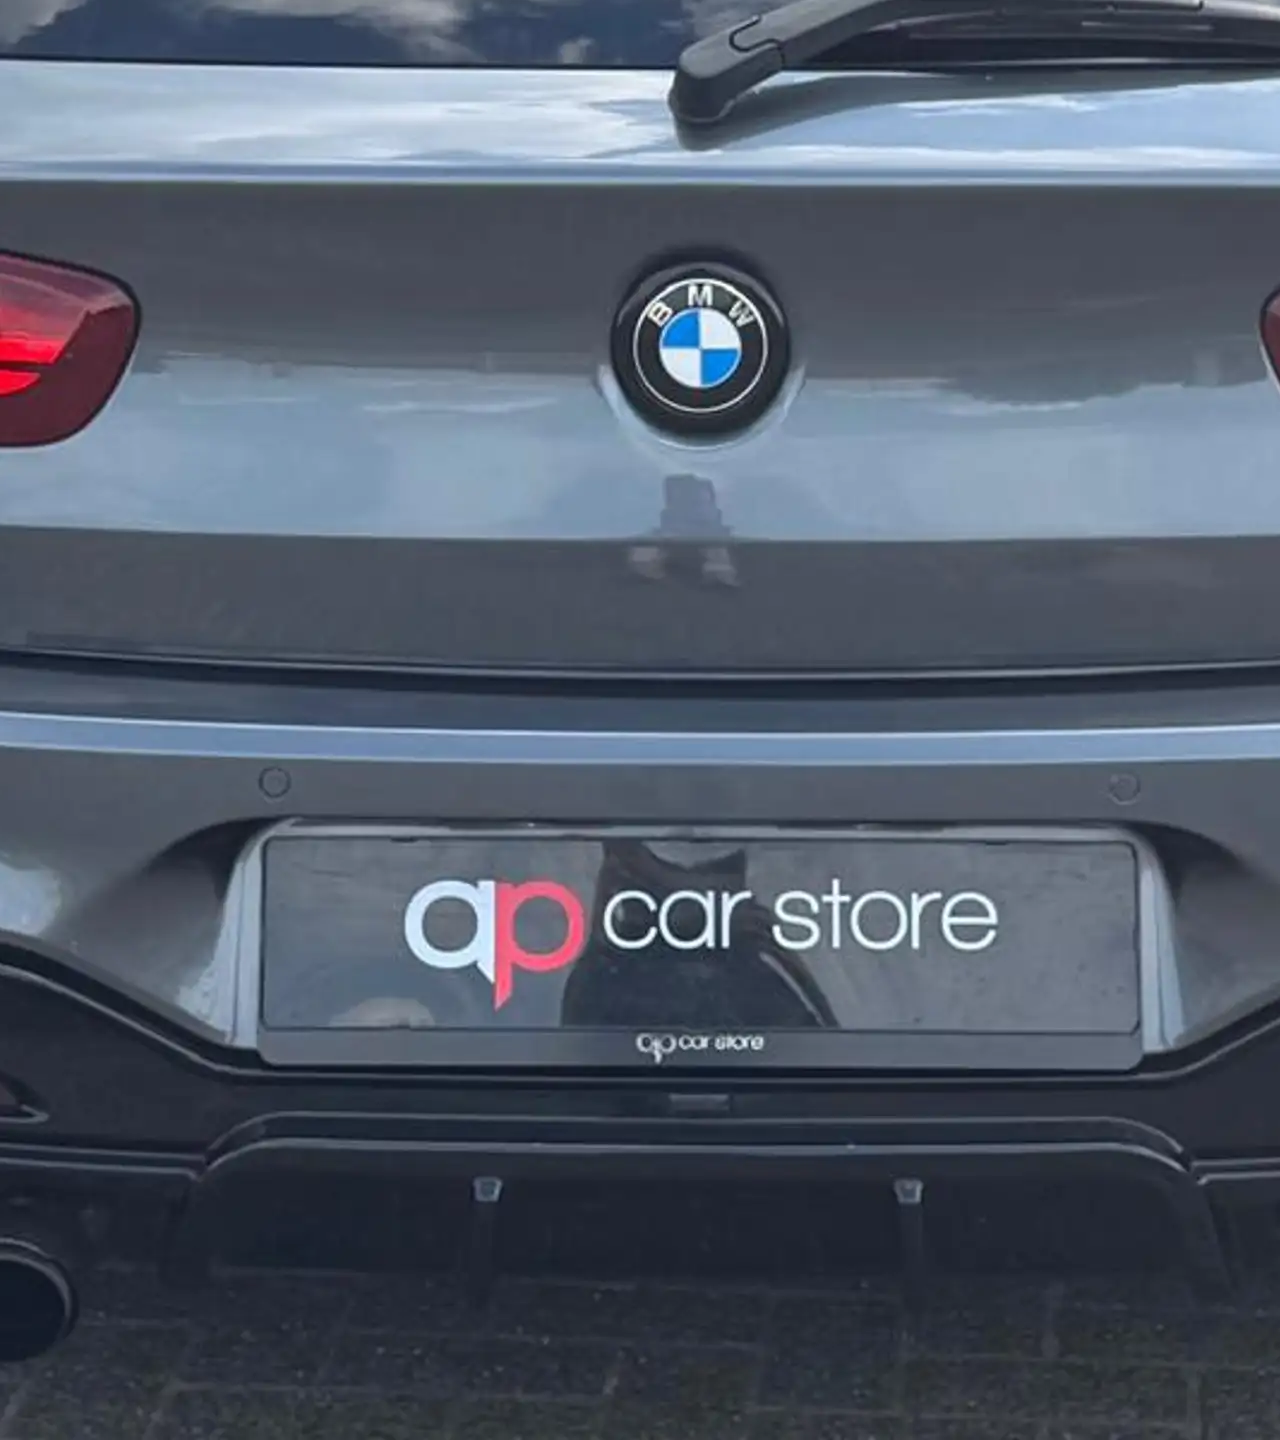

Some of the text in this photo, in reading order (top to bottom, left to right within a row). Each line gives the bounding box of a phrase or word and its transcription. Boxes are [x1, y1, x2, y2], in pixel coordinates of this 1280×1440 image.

[647, 284, 755, 328] BMW
[603, 889, 752, 951] car
[772, 878, 998, 951] store
[678, 1034, 710, 1050] car
